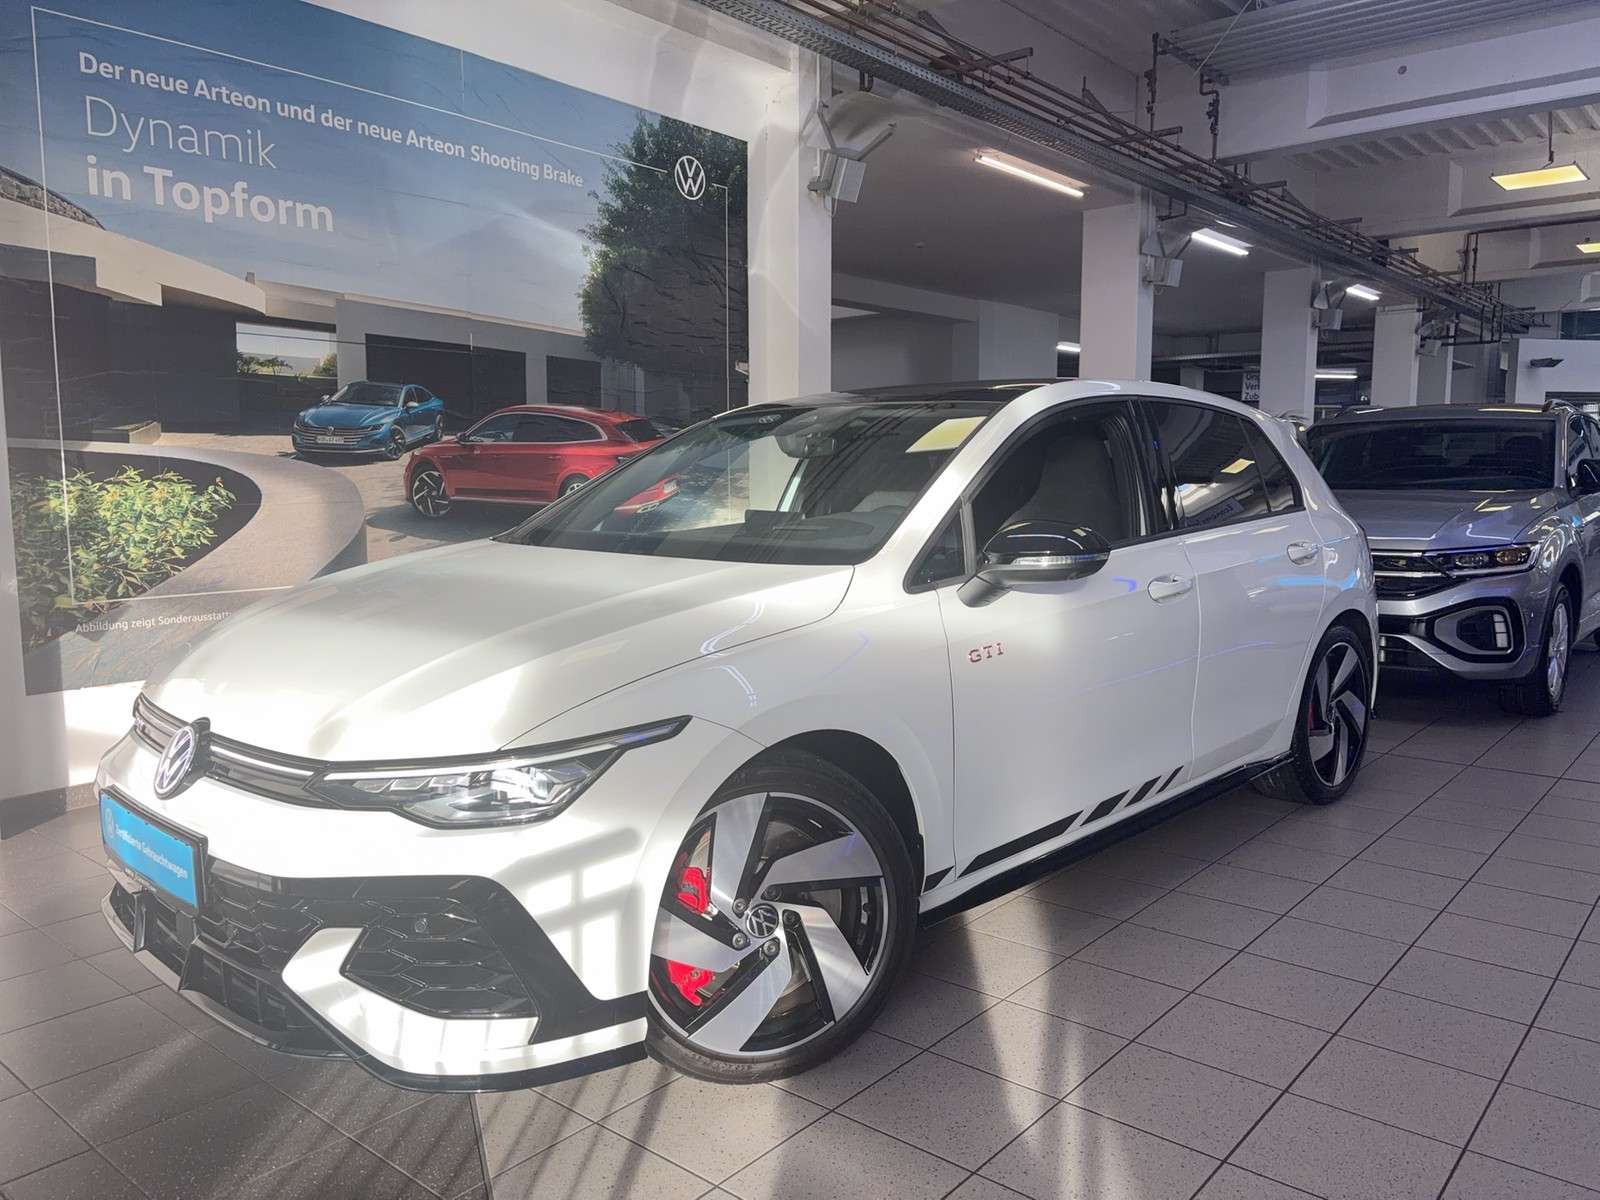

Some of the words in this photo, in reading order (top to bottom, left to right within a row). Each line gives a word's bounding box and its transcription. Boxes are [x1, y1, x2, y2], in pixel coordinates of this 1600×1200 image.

[79, 51, 124, 80] Der
[130, 70, 189, 94] neue
[194, 79, 271, 113] Arteon
[276, 100, 316, 123] und
[320, 108, 354, 131] der
[358, 121, 403, 143] neue
[406, 129, 465, 158] Arteon
[471, 144, 540, 180] Shooting
[543, 164, 584, 188] Brake
[85, 95, 277, 169] Dynamik
[86, 155, 132, 200] in
[143, 165, 334, 232] Topform
[75, 620, 128, 633] Abbildung
[131, 618, 155, 631] zeigt
[968, 642, 1004, 663] GTI
